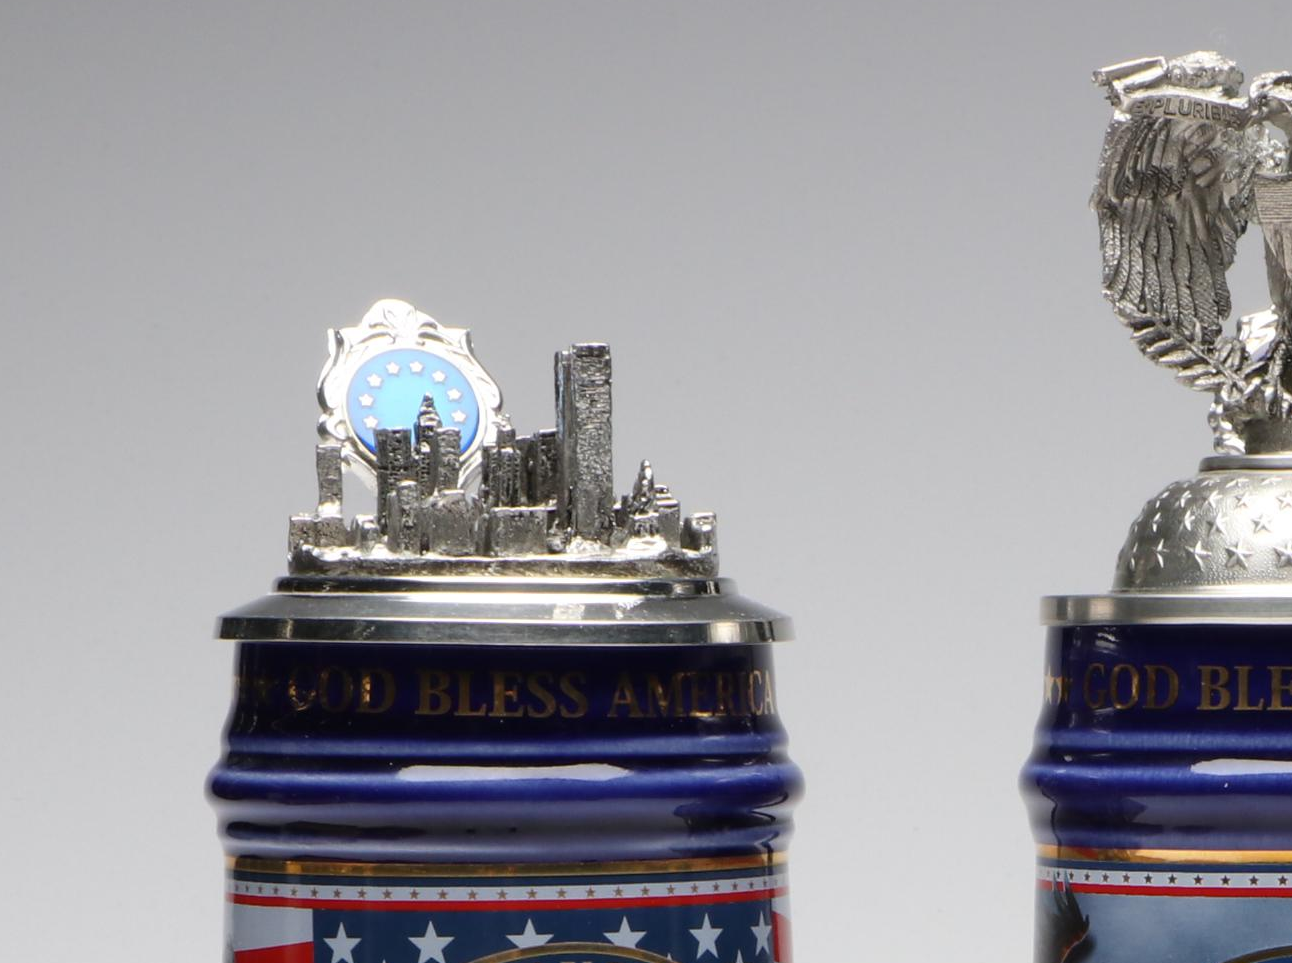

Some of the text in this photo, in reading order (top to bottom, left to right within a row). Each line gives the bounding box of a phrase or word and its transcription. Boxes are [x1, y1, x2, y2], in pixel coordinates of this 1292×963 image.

[288, 666, 776, 718] GOD BLESS AMERICA
[1083, 662, 1180, 711] GOD
